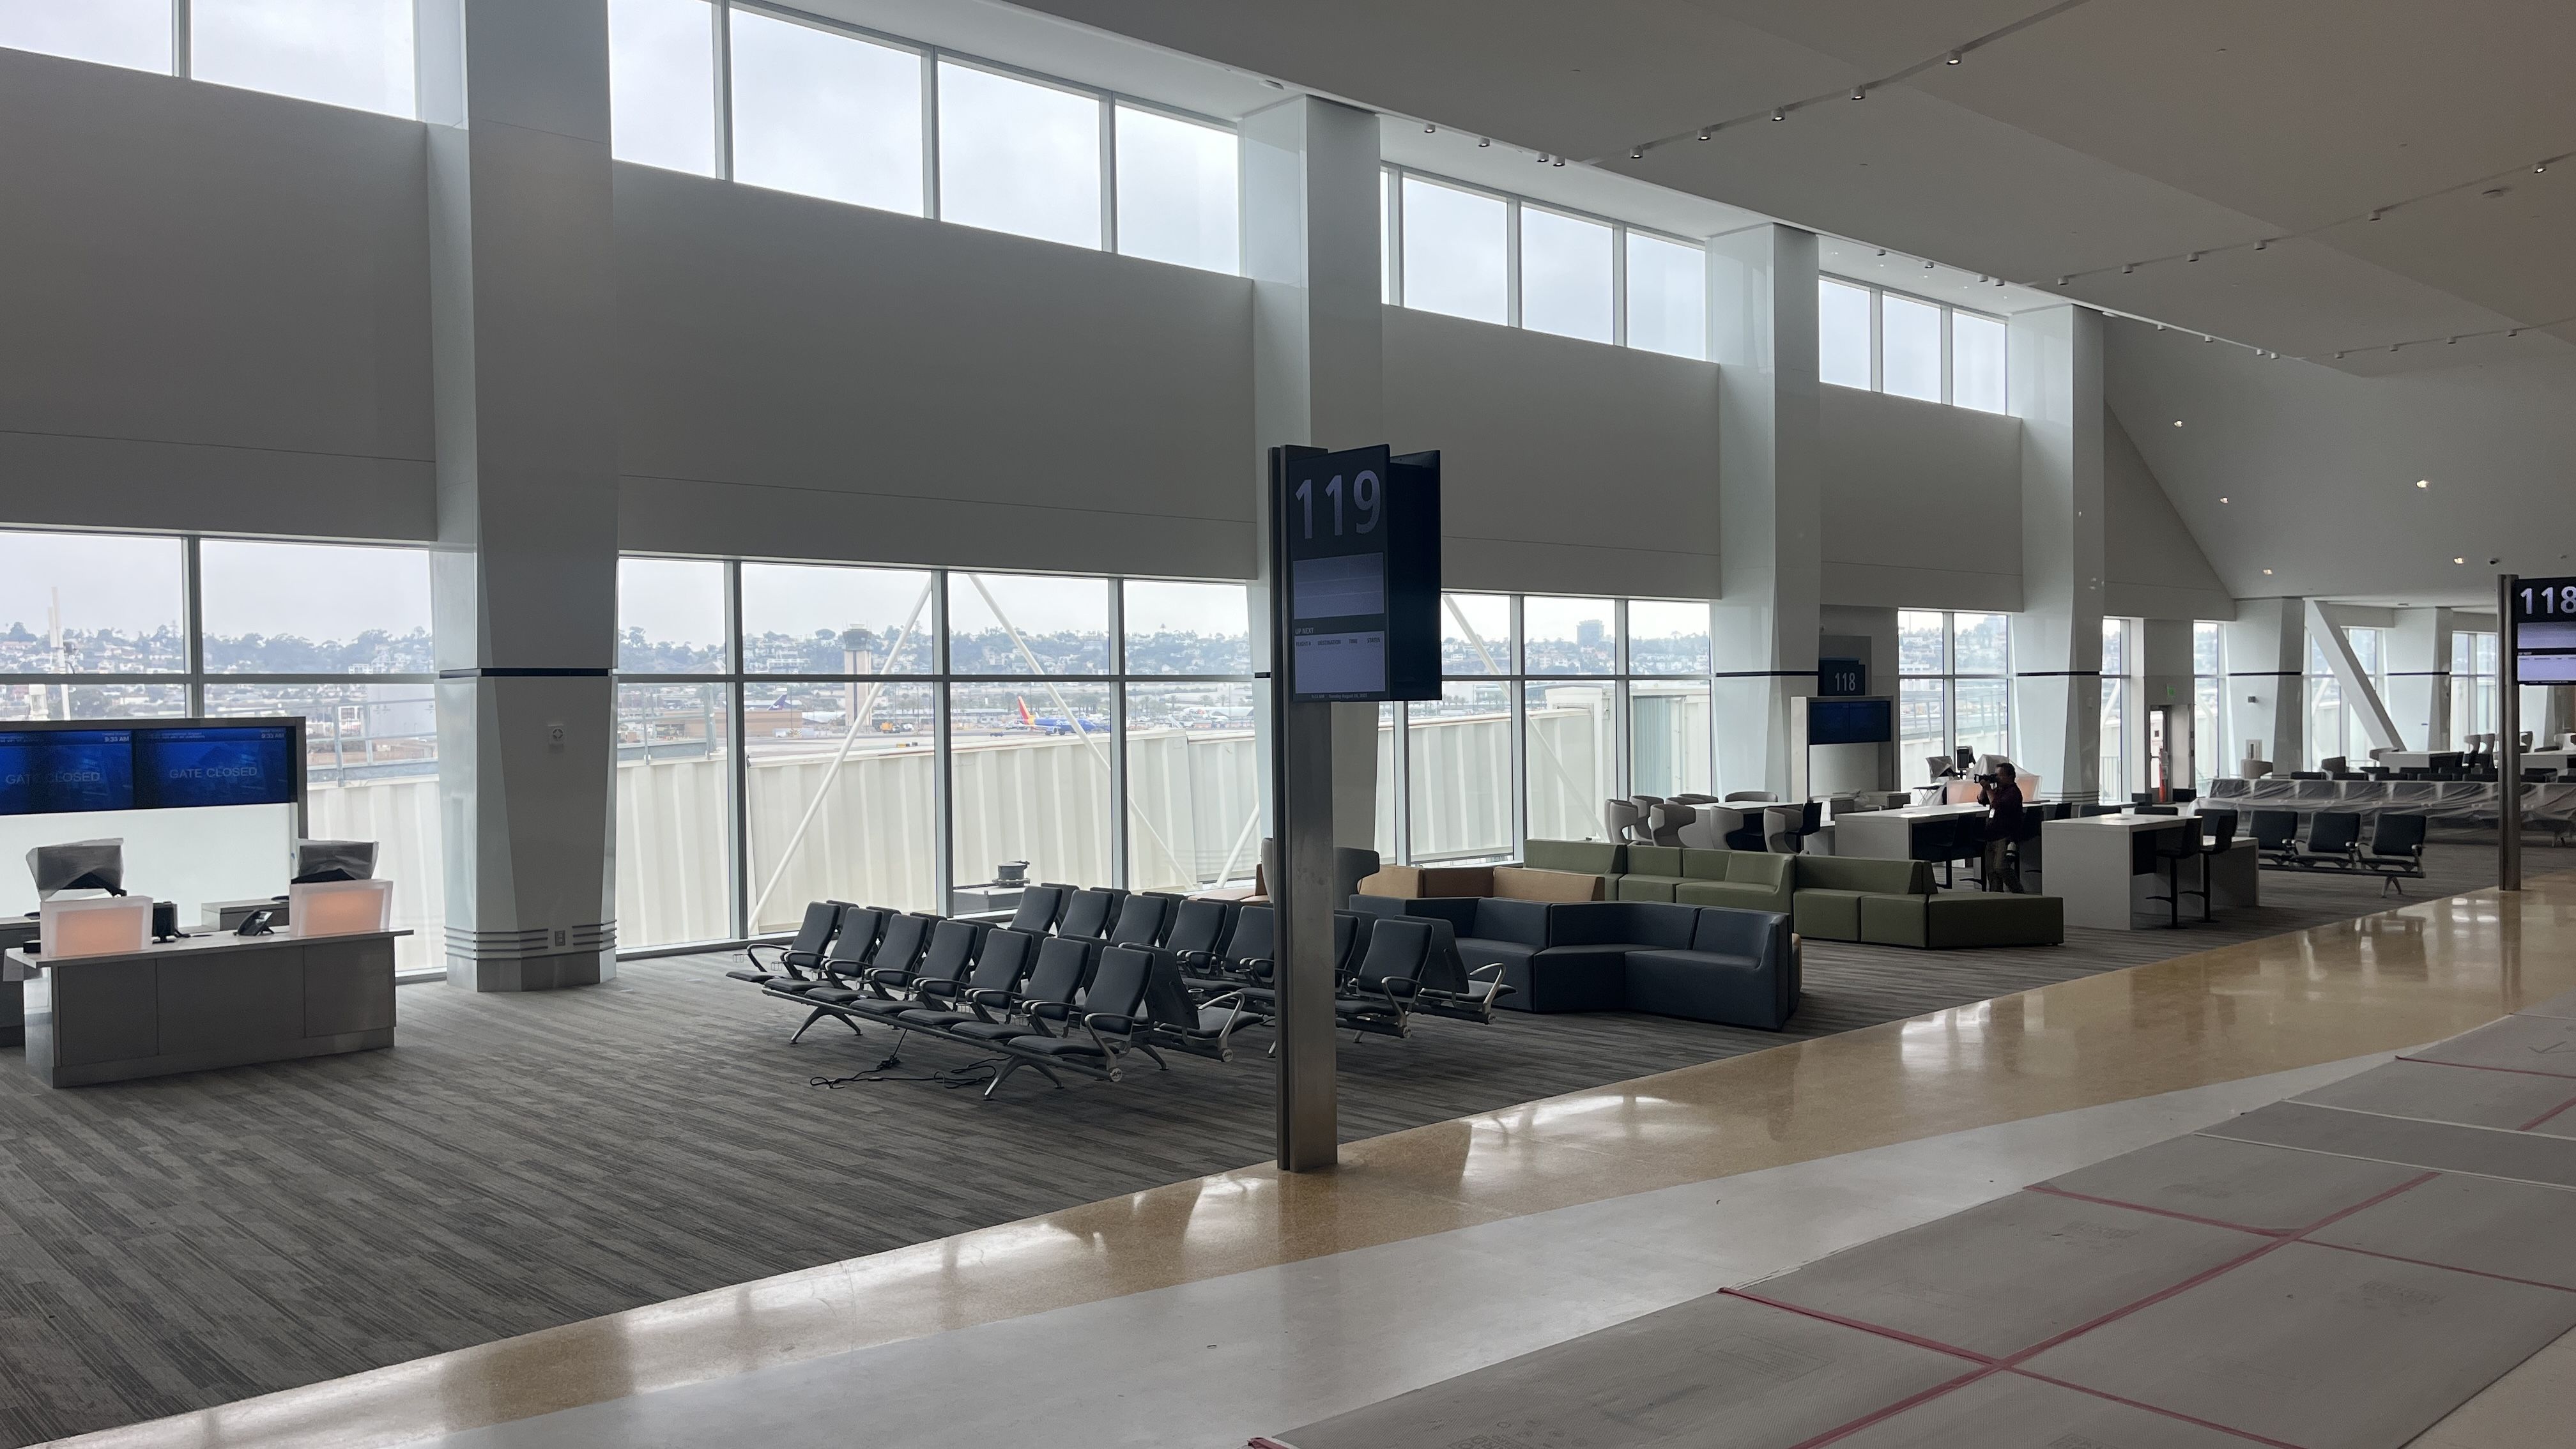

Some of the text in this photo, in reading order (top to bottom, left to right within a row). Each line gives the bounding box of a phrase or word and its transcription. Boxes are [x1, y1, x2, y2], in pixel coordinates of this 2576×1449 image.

[1295, 470, 1381, 539] 119
[2520, 586, 2576, 614] 118
[1835, 672, 1856, 691] 118
[5, 774, 37, 785] GAT
[169, 767, 257, 778] GATE CLOSED
